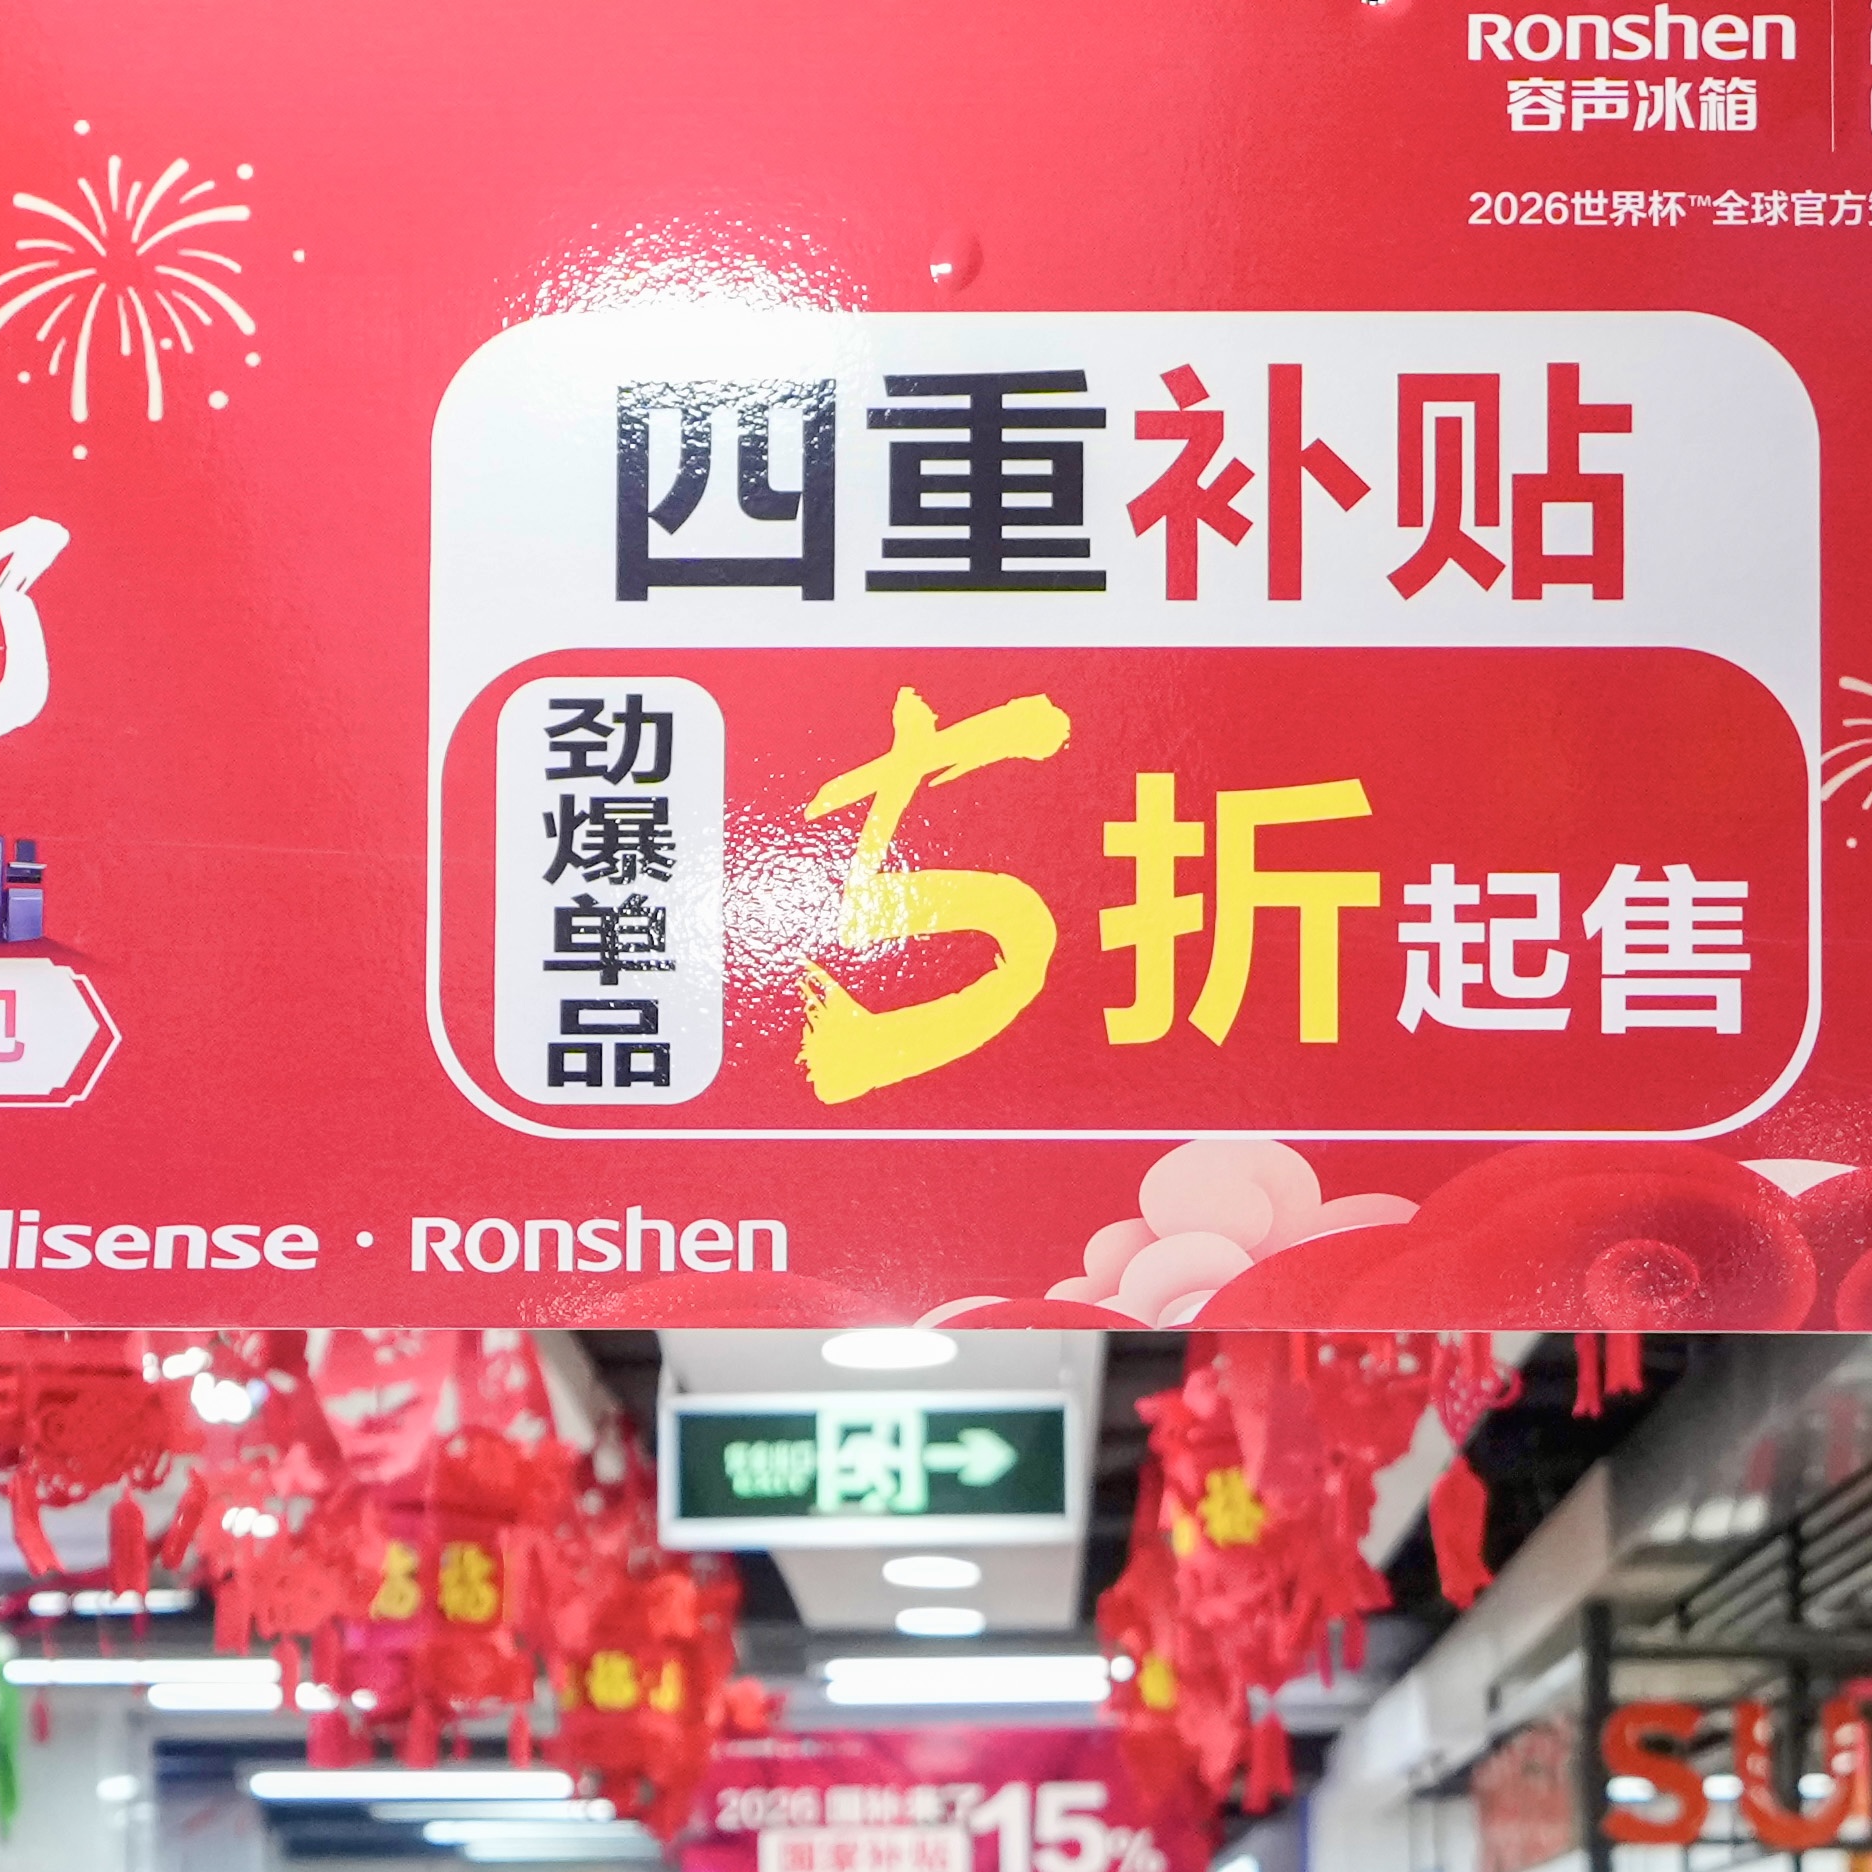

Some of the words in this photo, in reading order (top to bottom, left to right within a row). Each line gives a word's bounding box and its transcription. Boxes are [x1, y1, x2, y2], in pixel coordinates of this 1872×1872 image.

[1467, 3, 1796, 62] Ronshen
[1506, 77, 1757, 132] 容声冰箱
[614, 362, 1634, 602] 四重补贴
[542, 693, 676, 1089] 劲爆单品
[409, 1204, 790, 1273] Ronshen
